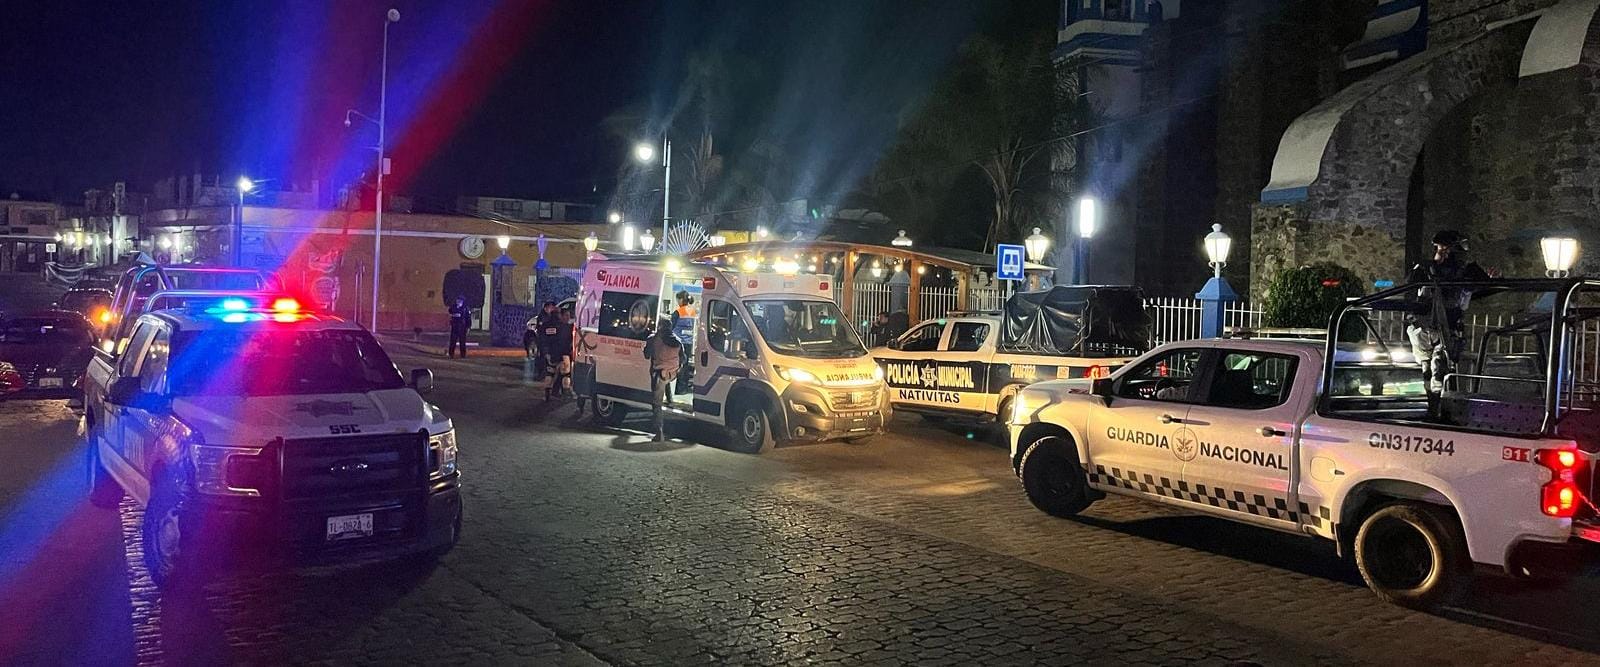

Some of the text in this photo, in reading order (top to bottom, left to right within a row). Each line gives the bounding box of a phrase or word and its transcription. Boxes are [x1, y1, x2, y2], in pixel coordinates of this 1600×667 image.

[887, 361, 975, 389] POLICÍA MUNICIPAL
[900, 390, 960, 403] NATIVITAS
[330, 424, 361, 434] SSC
[1107, 426, 1288, 470] GUARDIA NACIONAL
[1368, 432, 1455, 456] GN317344
[1503, 447, 1530, 461] 911
